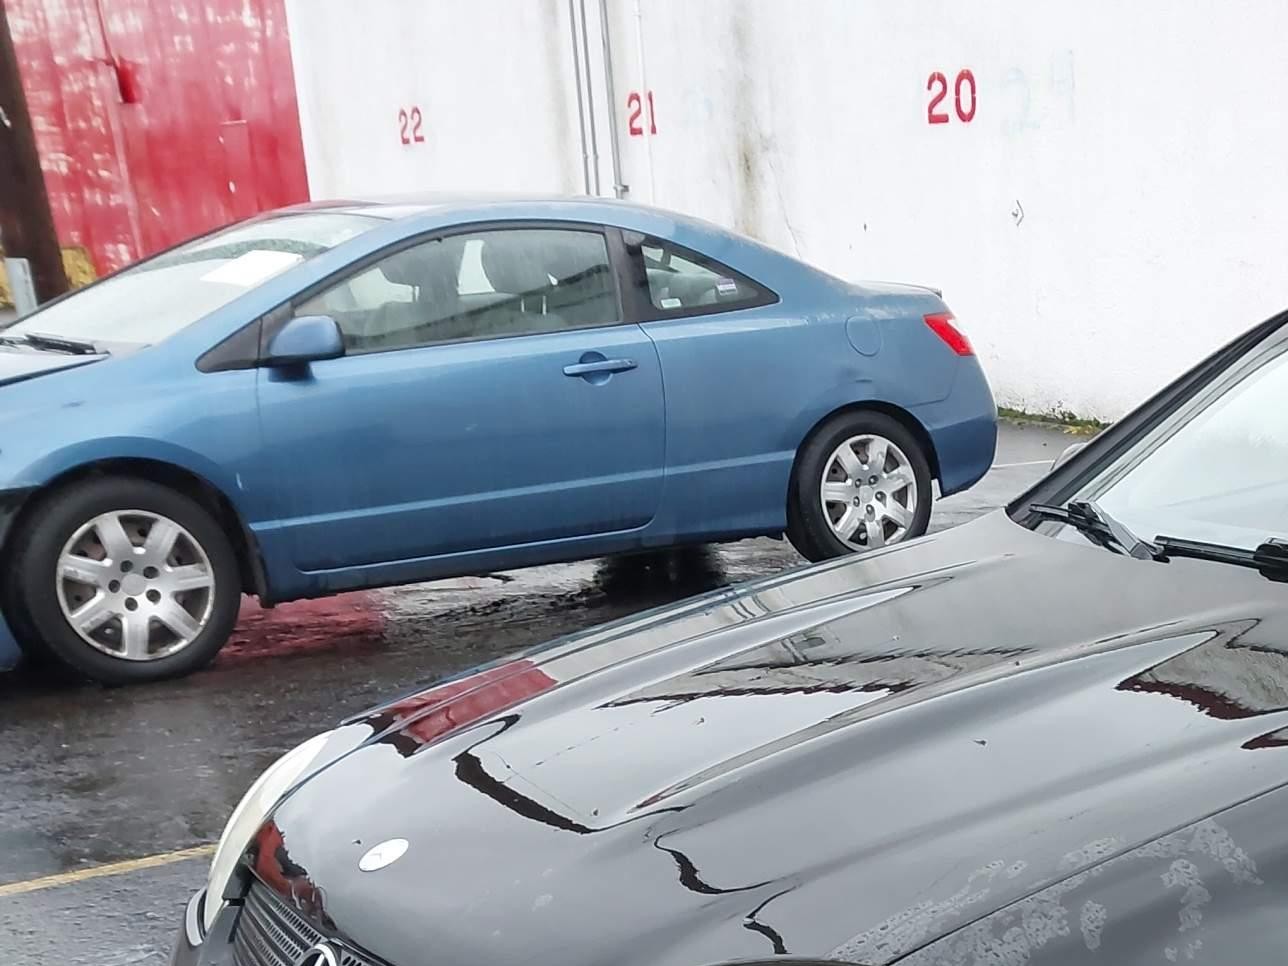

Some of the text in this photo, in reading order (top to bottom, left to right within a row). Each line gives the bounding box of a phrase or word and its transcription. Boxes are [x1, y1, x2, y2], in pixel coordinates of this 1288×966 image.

[627, 90, 657, 136] 21
[927, 69, 977, 124] 20
[399, 106, 424, 145] 22
